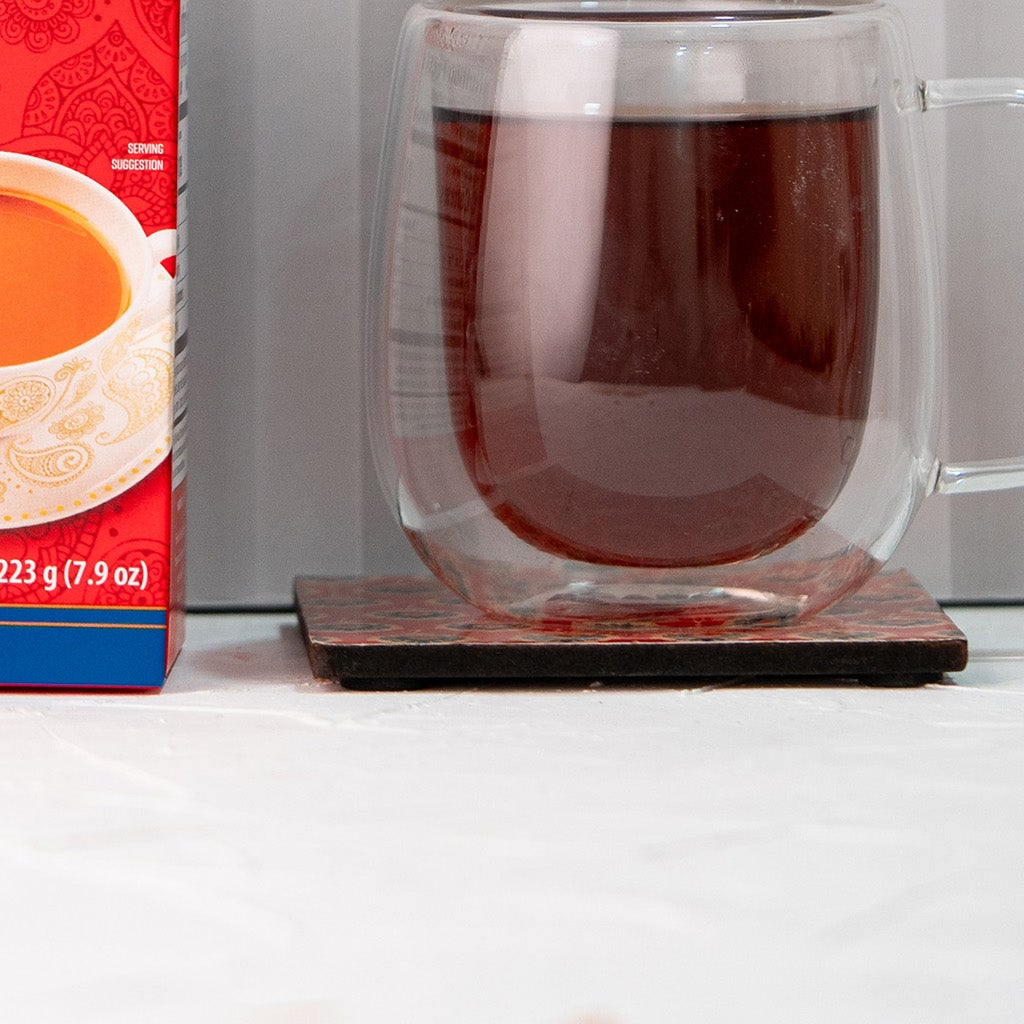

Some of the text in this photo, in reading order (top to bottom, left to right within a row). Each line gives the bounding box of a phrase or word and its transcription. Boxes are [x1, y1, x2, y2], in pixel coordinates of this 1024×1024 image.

[128, 143, 163, 154] SERVING
[112, 159, 163, 170] SUGGESTION
[44, 566, 57, 590] g
[64, 560, 108, 588] (7.9
[114, 561, 147, 589] oz)
